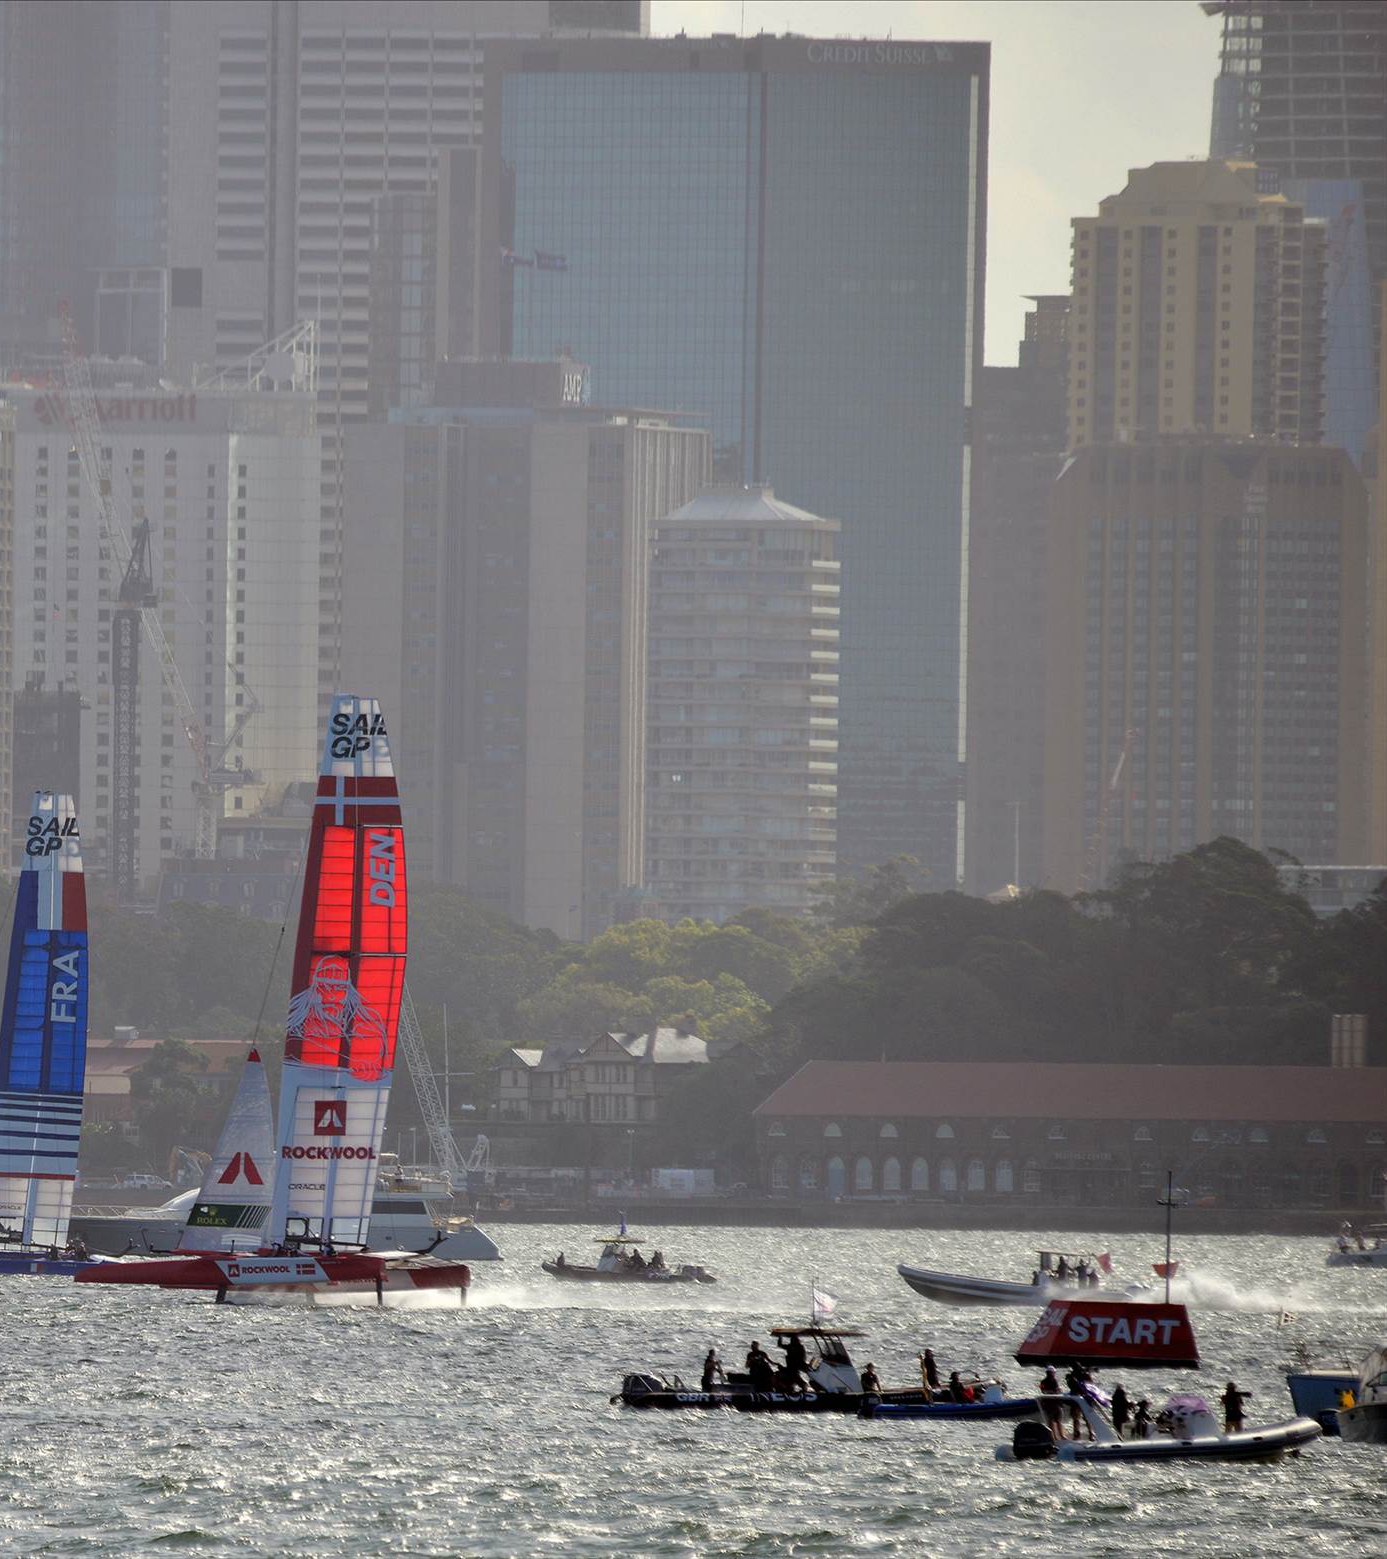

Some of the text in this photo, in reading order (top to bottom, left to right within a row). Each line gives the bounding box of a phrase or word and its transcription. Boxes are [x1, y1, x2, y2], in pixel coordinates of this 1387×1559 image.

[806, 43, 928, 64] CREDIT SUISSE
[562, 373, 582, 403] AMP
[330, 736, 371, 759] GP
[27, 816, 80, 837] SAIL
[25, 837, 63, 857] GP
[370, 831, 396, 908] DEN
[50, 950, 79, 1023] FRA
[281, 1145, 377, 1160] ROCKWOOL
[287, 1183, 326, 1191] ORACLE
[196, 1216, 228, 1226] ROLEX
[242, 1264, 291, 1275] ROCKWOOL
[1068, 1315, 1182, 1345] START
[676, 1392, 710, 1402] GBR
